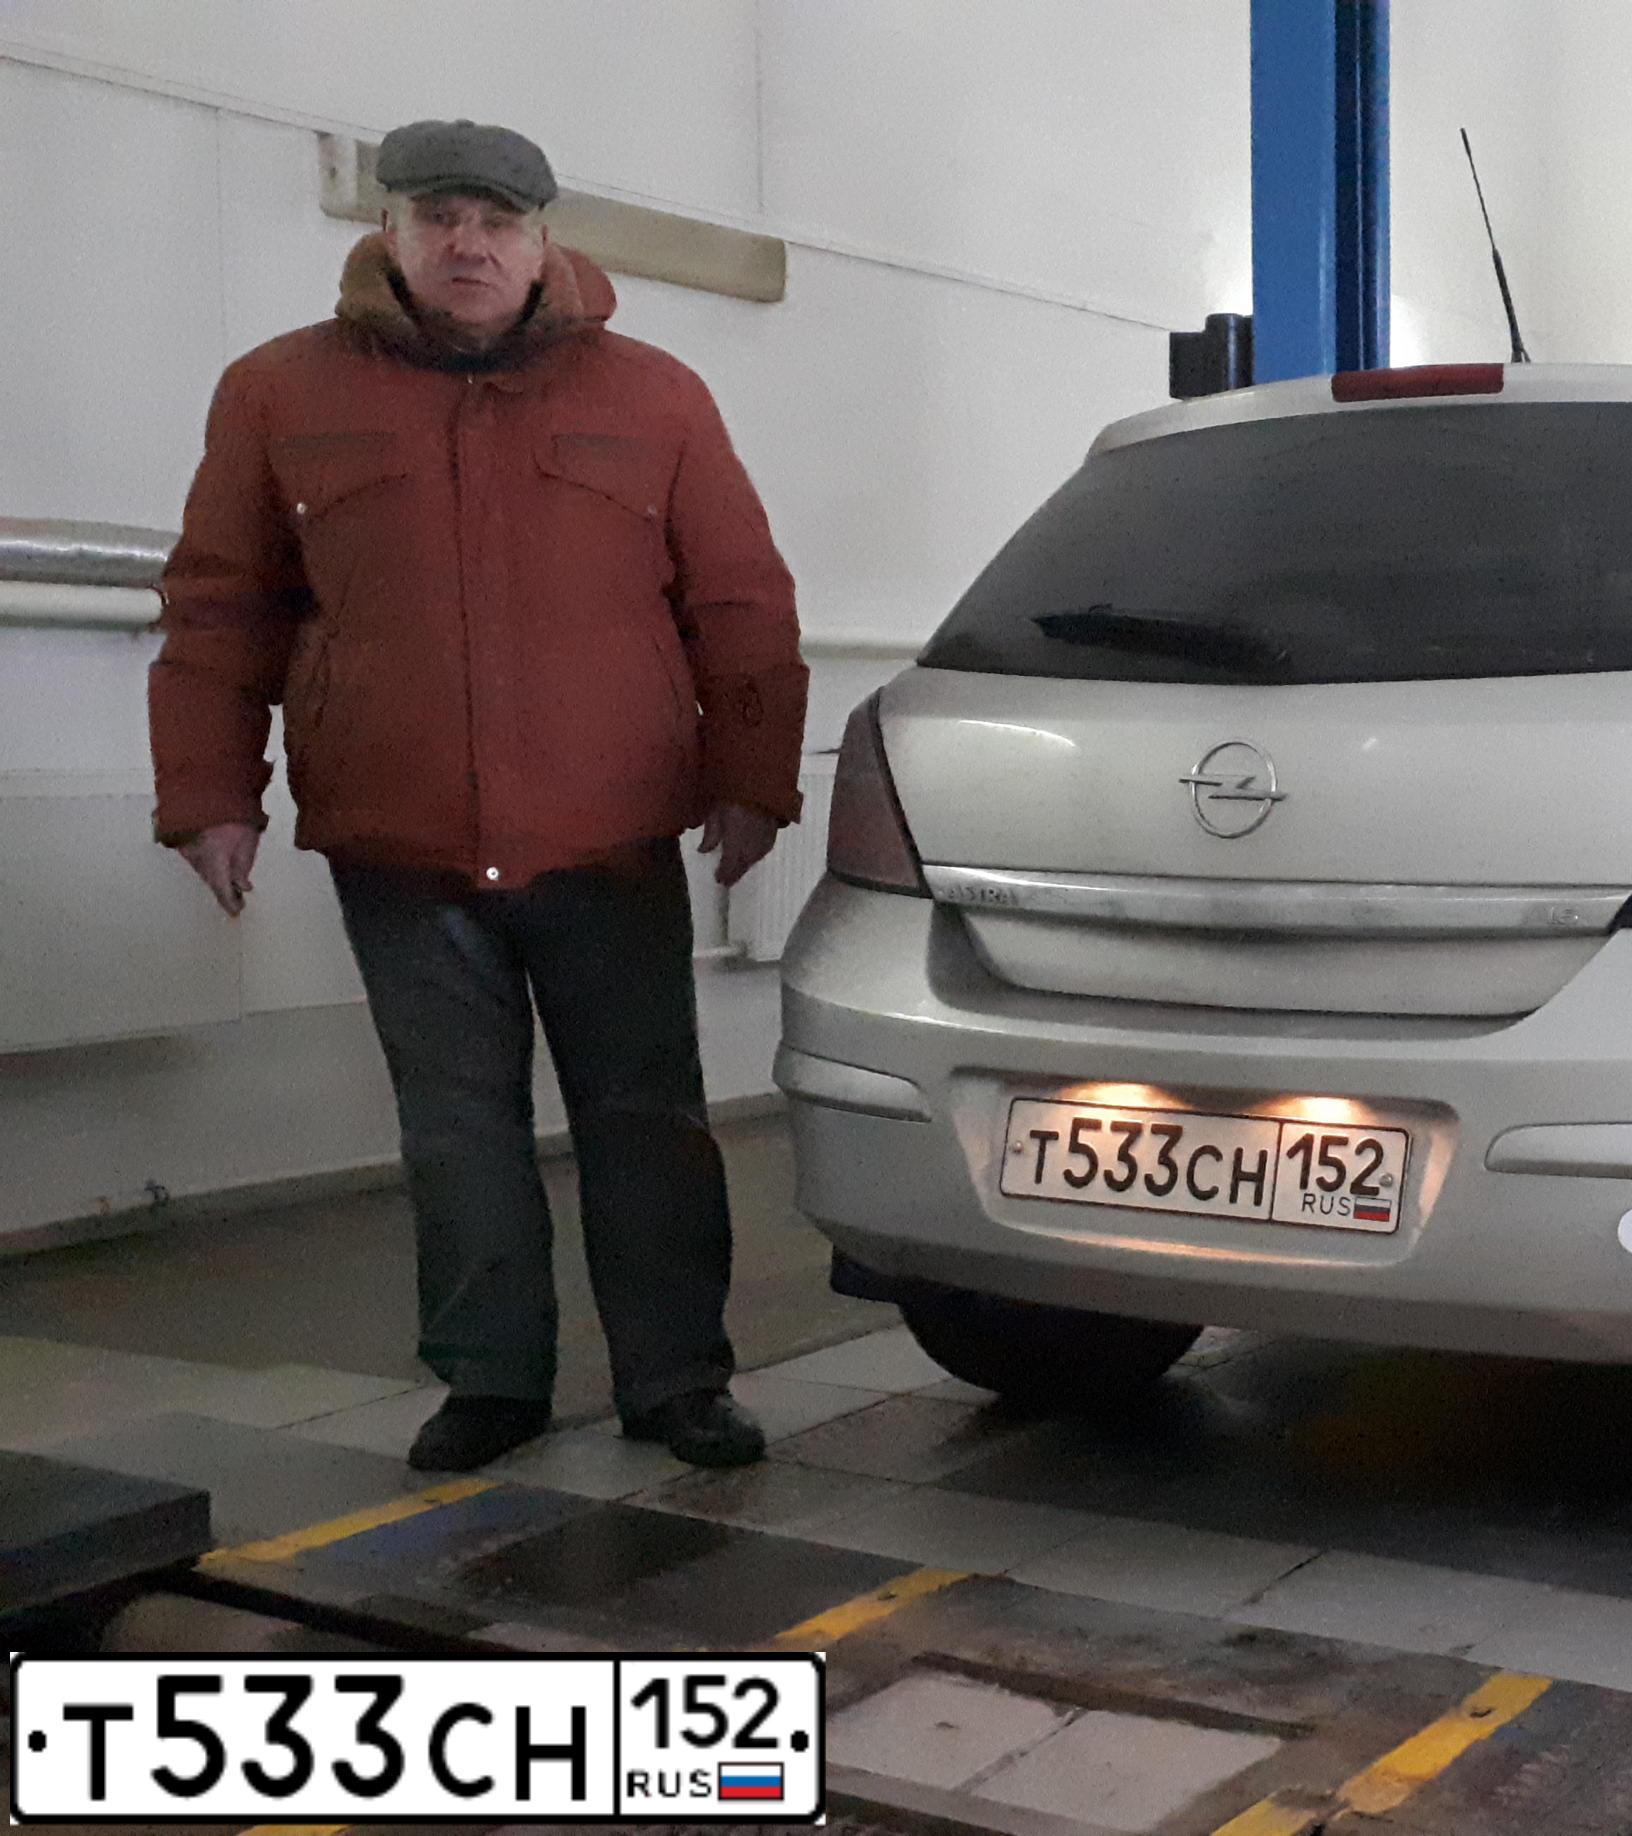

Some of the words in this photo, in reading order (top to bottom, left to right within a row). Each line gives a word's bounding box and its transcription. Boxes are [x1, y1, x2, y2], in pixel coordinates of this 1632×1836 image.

[1029, 1116, 1268, 1207] Т533СН
[1286, 1132, 1385, 1197] 152
[1301, 1193, 1351, 1217] RUS
